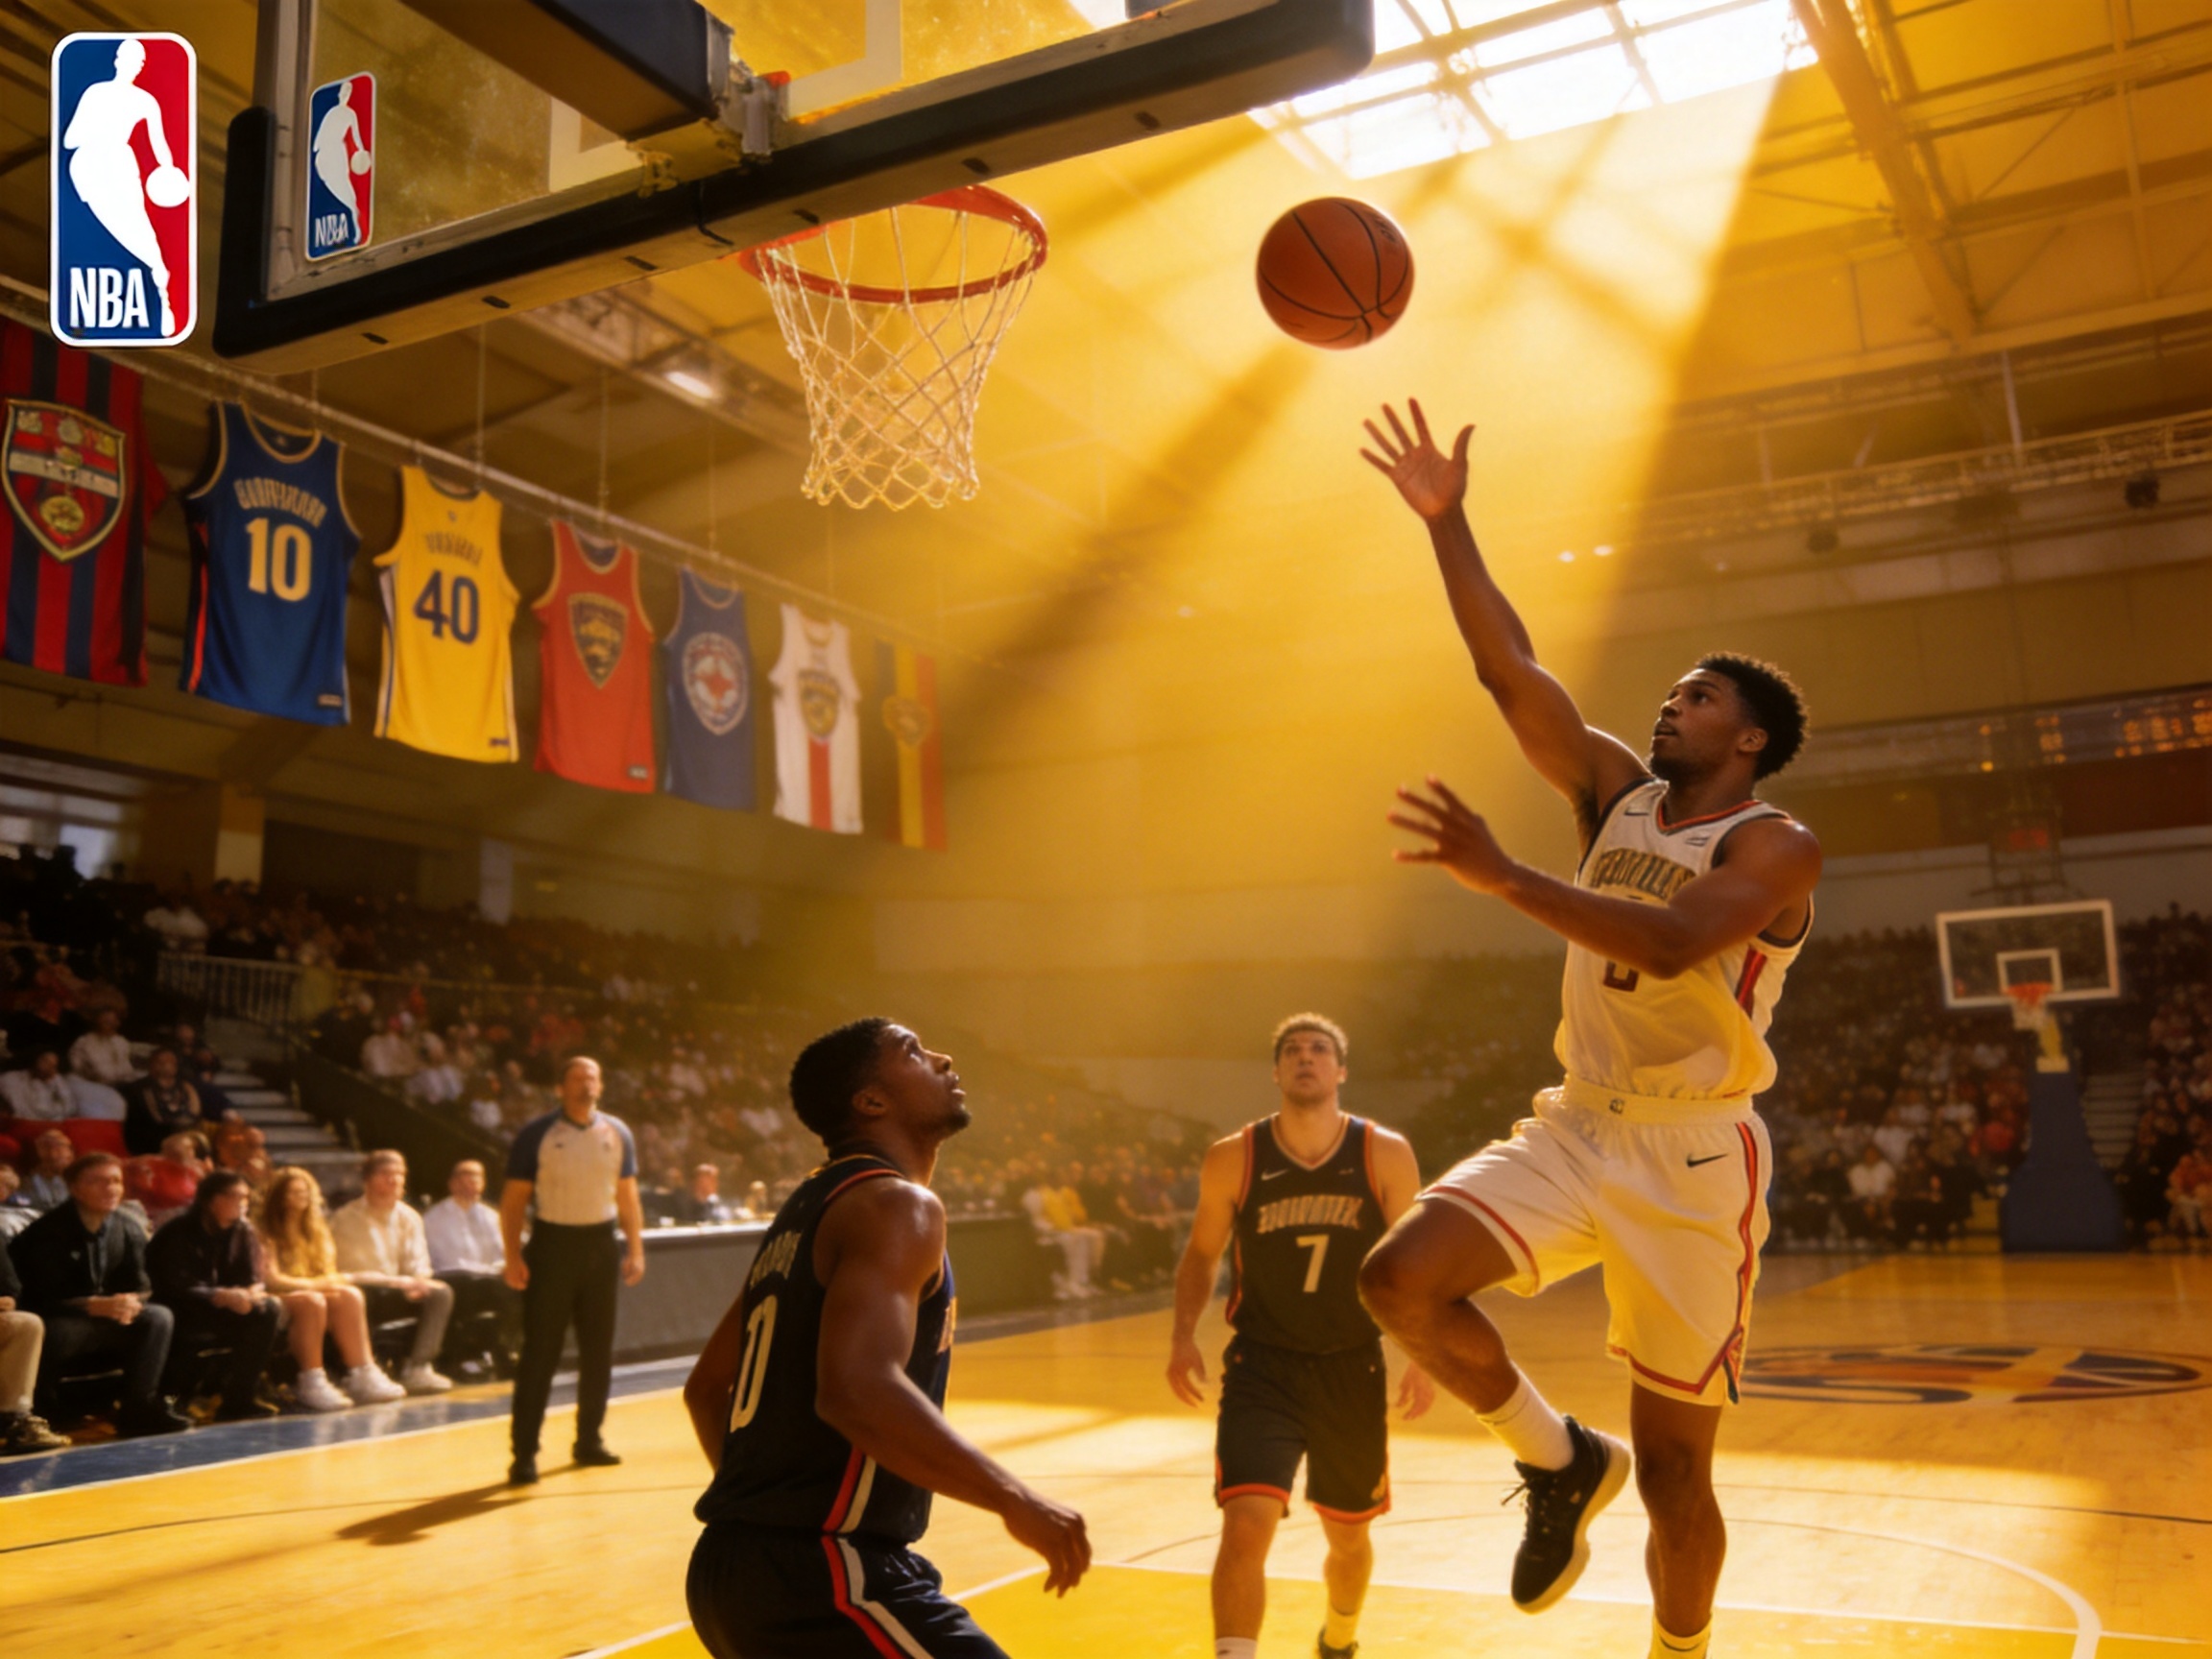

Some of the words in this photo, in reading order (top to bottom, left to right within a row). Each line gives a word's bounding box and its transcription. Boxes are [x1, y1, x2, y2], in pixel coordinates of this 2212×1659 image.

[245, 517, 312, 602] 10
[413, 569, 480, 645] 40
[1296, 1234, 1330, 1293] 7
